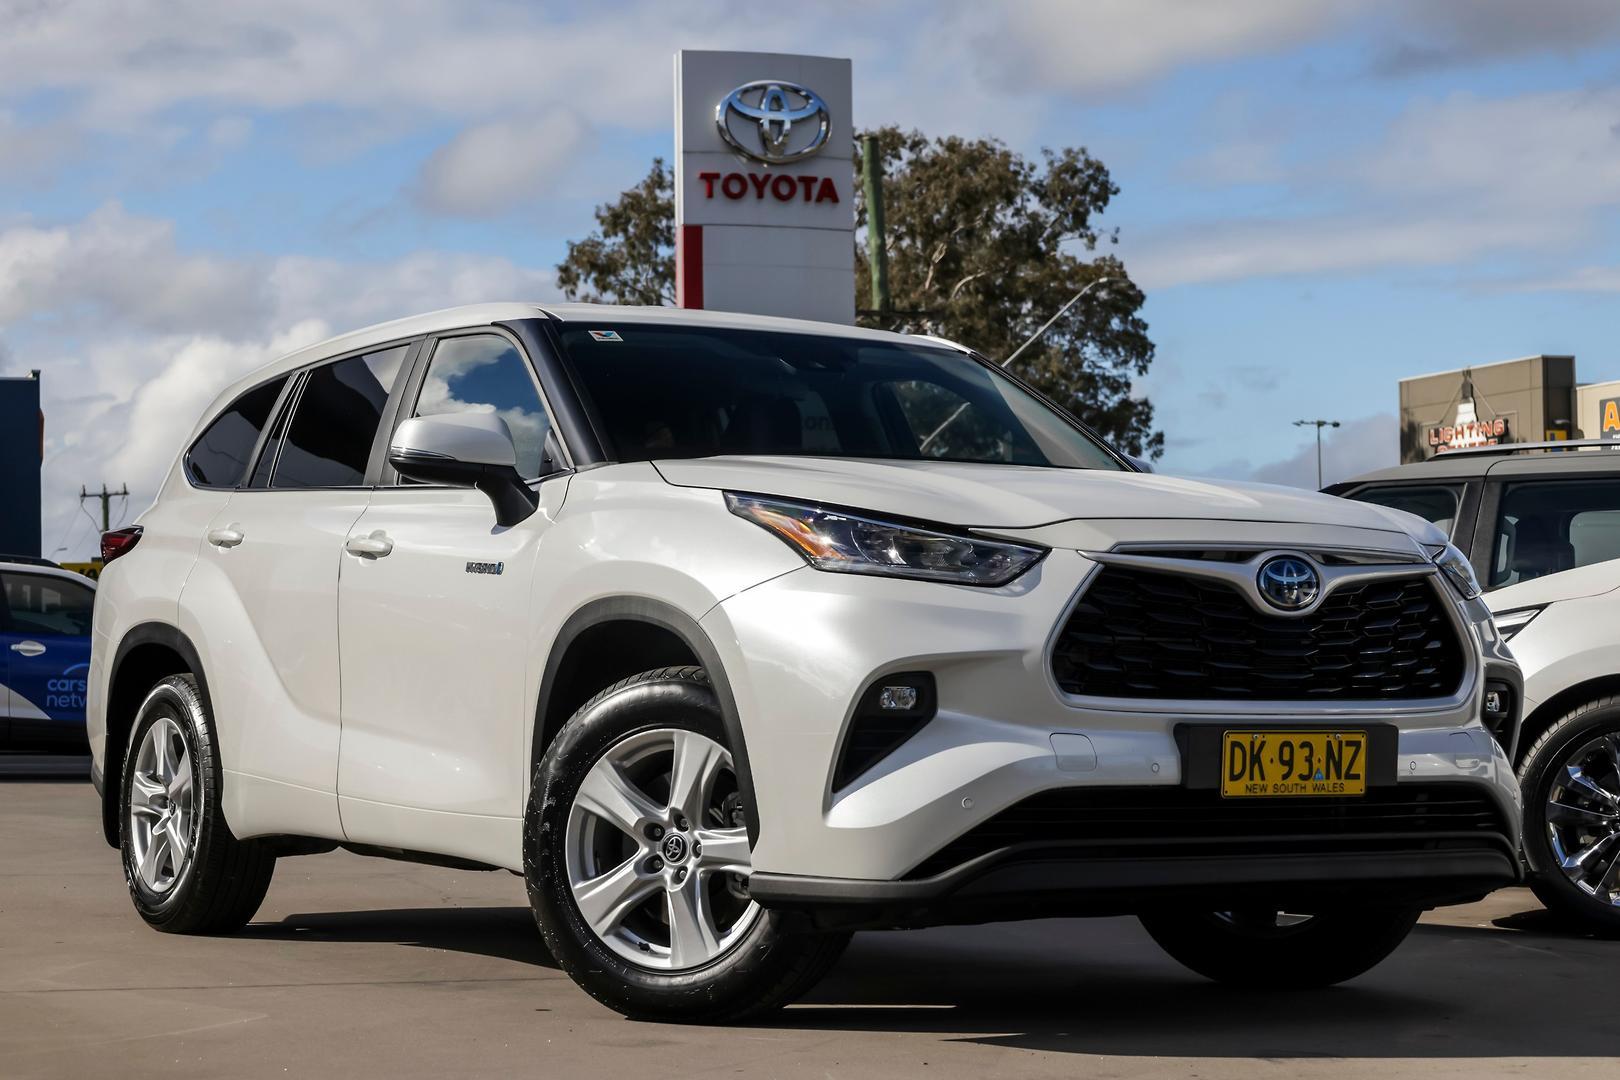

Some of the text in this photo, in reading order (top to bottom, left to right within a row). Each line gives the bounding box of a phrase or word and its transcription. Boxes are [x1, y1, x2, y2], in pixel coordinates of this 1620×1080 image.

[699, 172, 840, 204] TOYOTA
[1603, 400, 1620, 432] A
[1429, 418, 1506, 445] LIGHTING
[47, 678, 87, 692] cars
[1245, 782, 1345, 794] NEW SOUTH WALES
